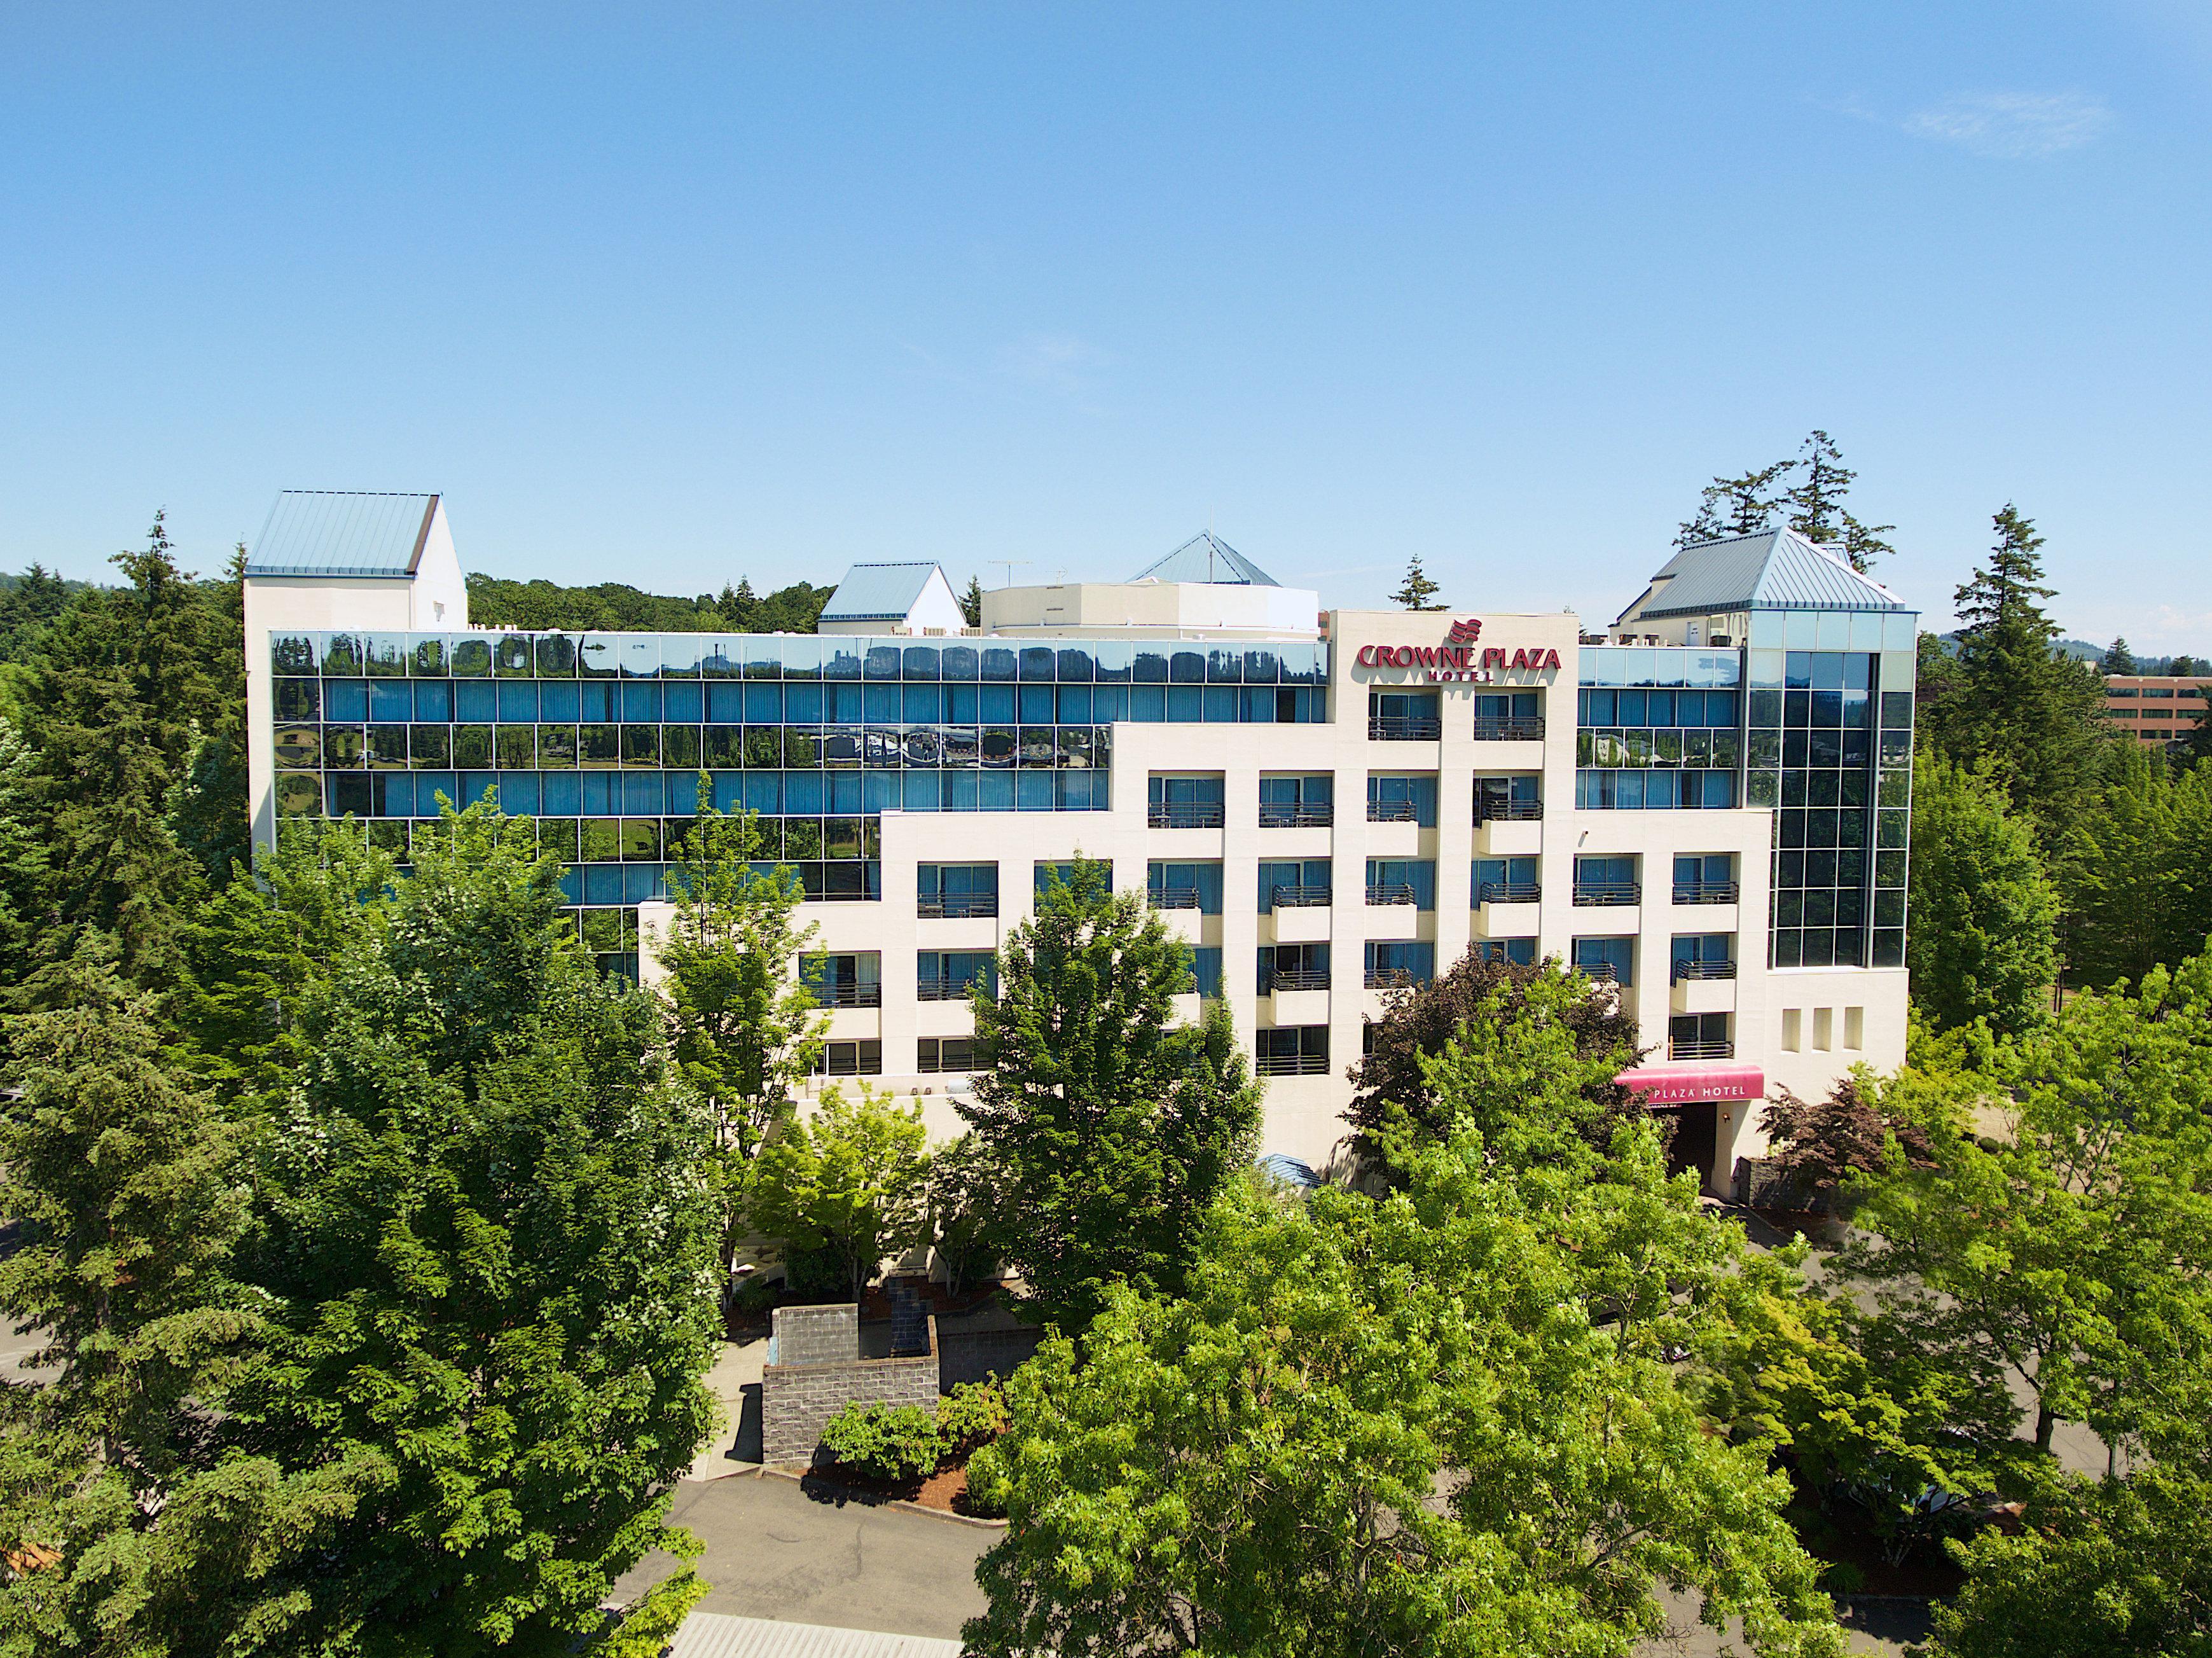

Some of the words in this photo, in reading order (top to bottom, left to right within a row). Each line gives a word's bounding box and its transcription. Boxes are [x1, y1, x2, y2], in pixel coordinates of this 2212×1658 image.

[1358, 646, 1476, 668] CROWNE
[1484, 648, 1561, 669] PLAZA
[1428, 671, 1493, 682] HOTEL
[1654, 1088, 1694, 1098] PLAZA
[1703, 1086, 1745, 1096] HOTEL
